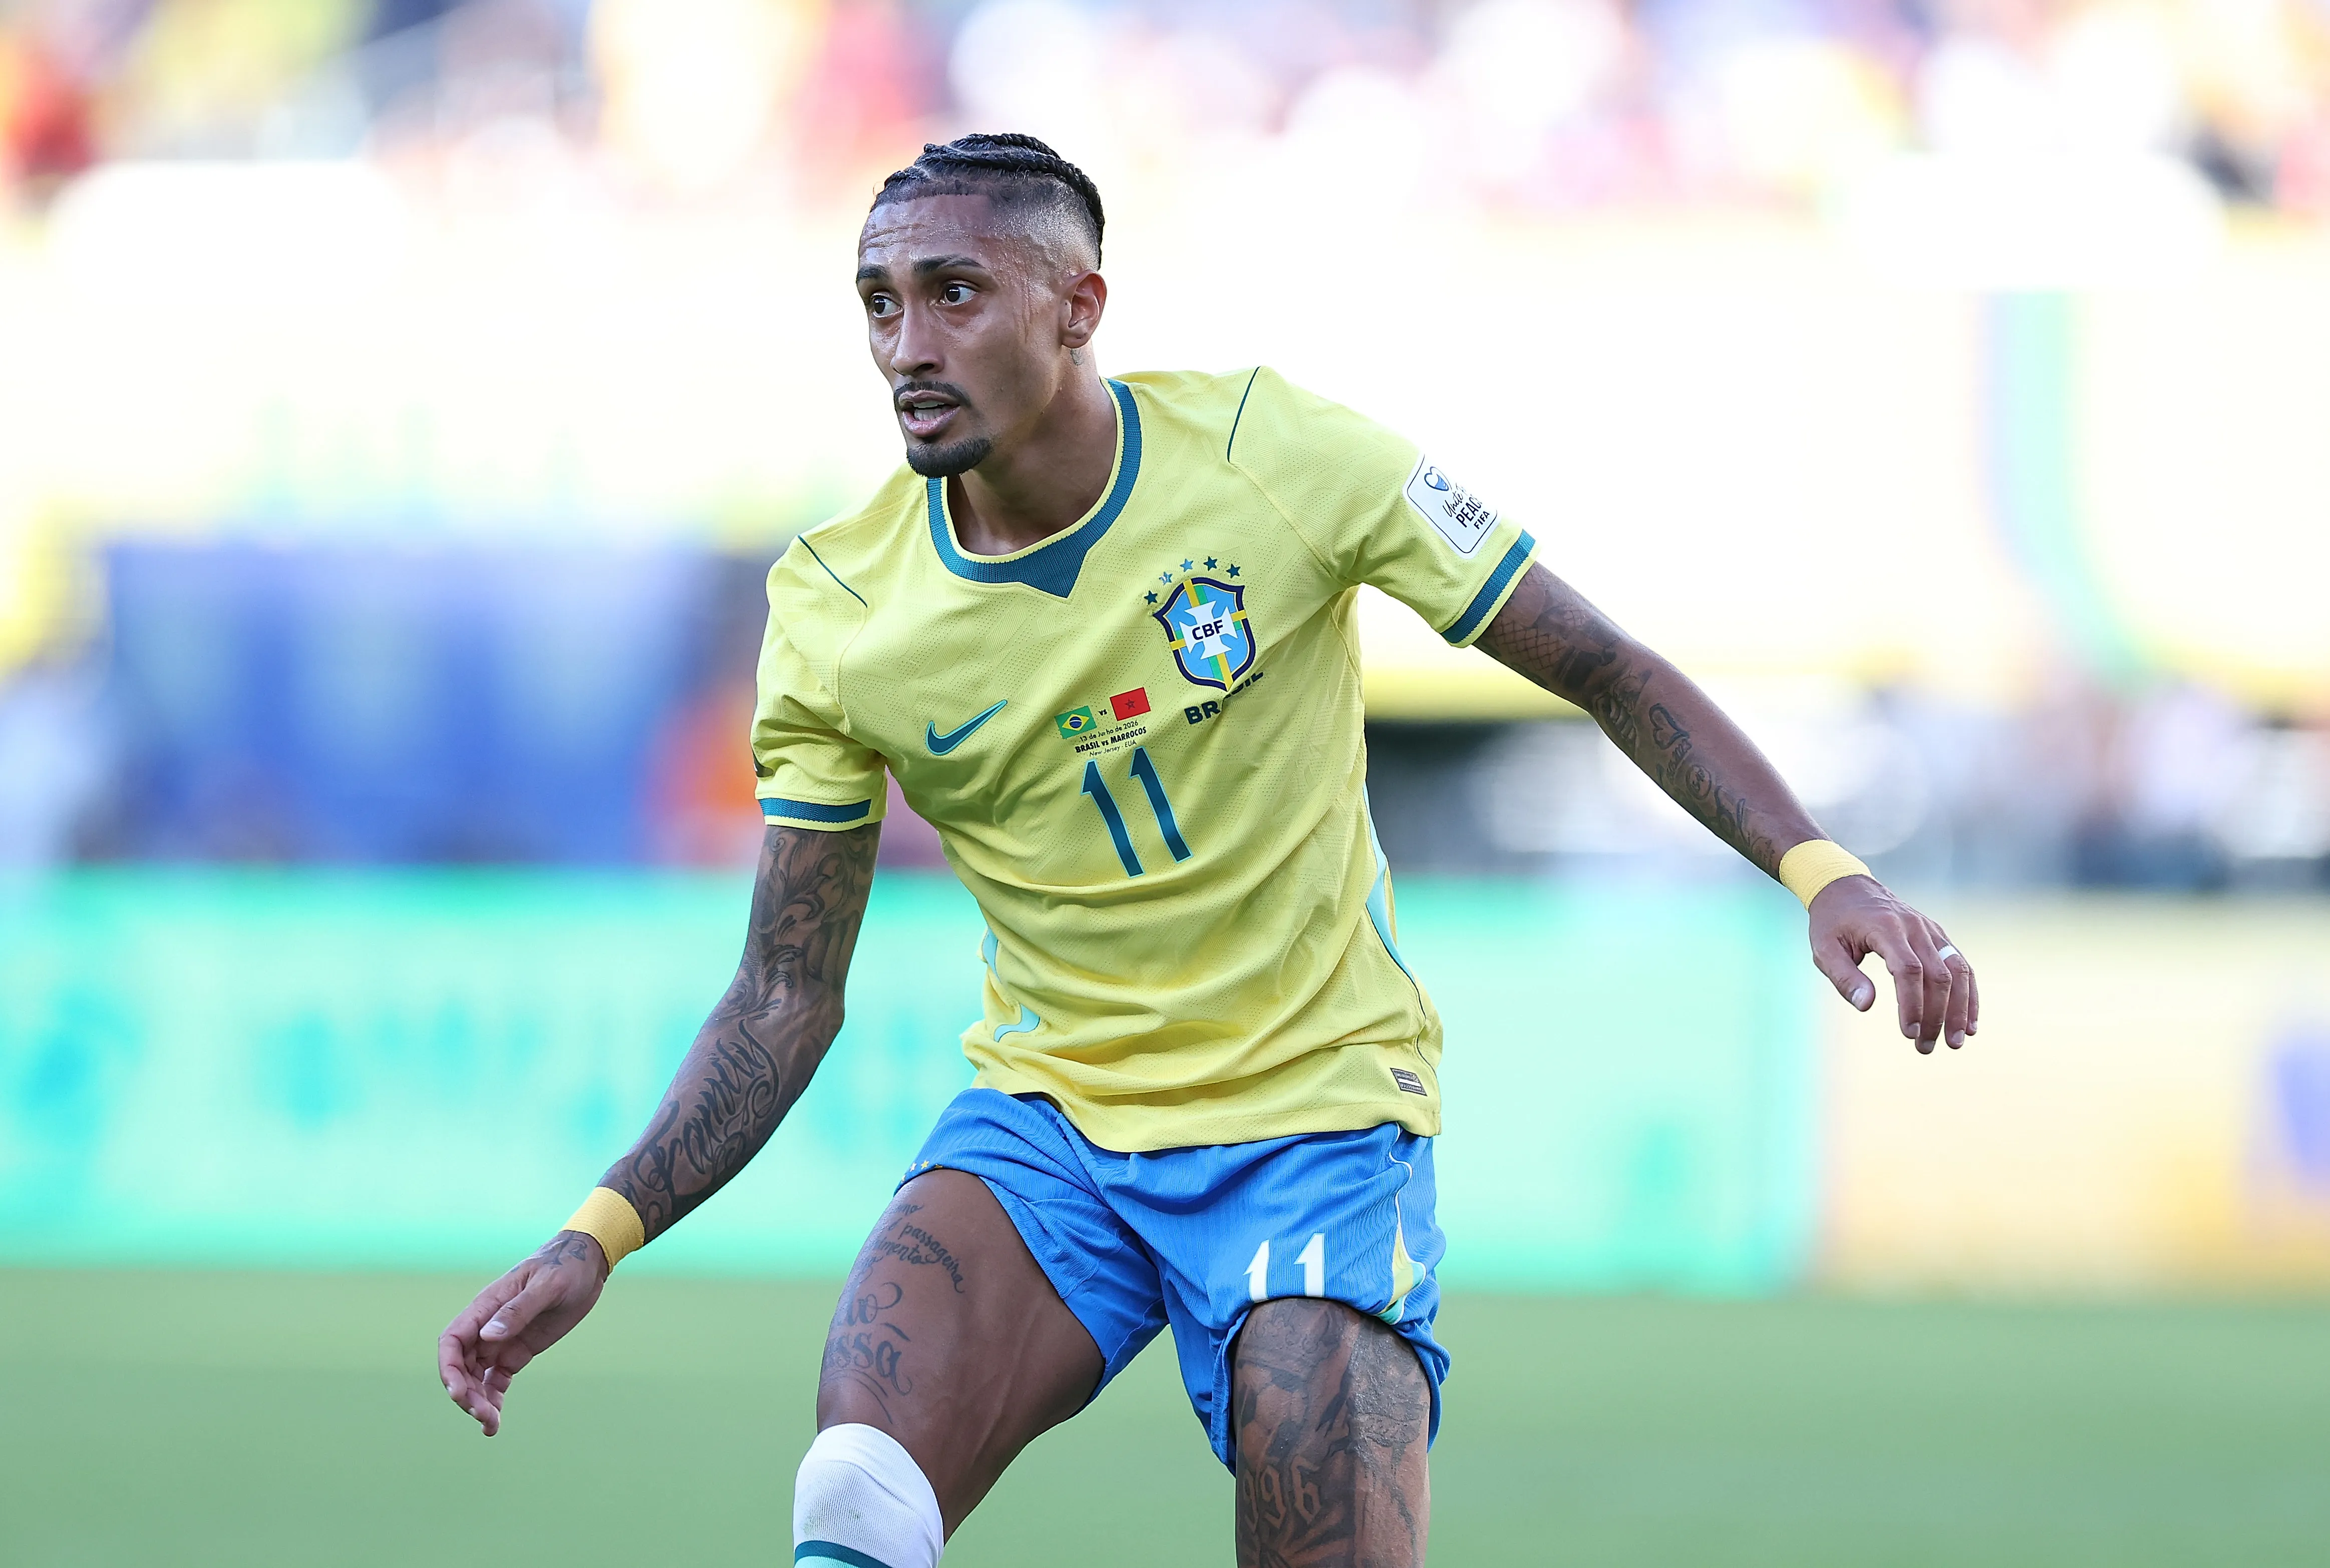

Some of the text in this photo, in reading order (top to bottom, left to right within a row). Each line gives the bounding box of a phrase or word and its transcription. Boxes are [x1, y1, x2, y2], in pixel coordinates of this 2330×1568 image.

[1443, 491, 1463, 517] Unite
[1474, 511, 1490, 530] FIFA
[1192, 619, 1223, 641] CBF
[1184, 672, 1264, 725] BRSIL
[1123, 720, 1138, 730] 2026
[1075, 741, 1100, 753] BRASIL
[1110, 726, 1147, 744] MARROCOS
[1104, 746, 1120, 754] Jersey
[1125, 740, 1137, 748] EUA
[1080, 746, 1194, 879] 11
[1242, 1233, 1325, 1303] 11
